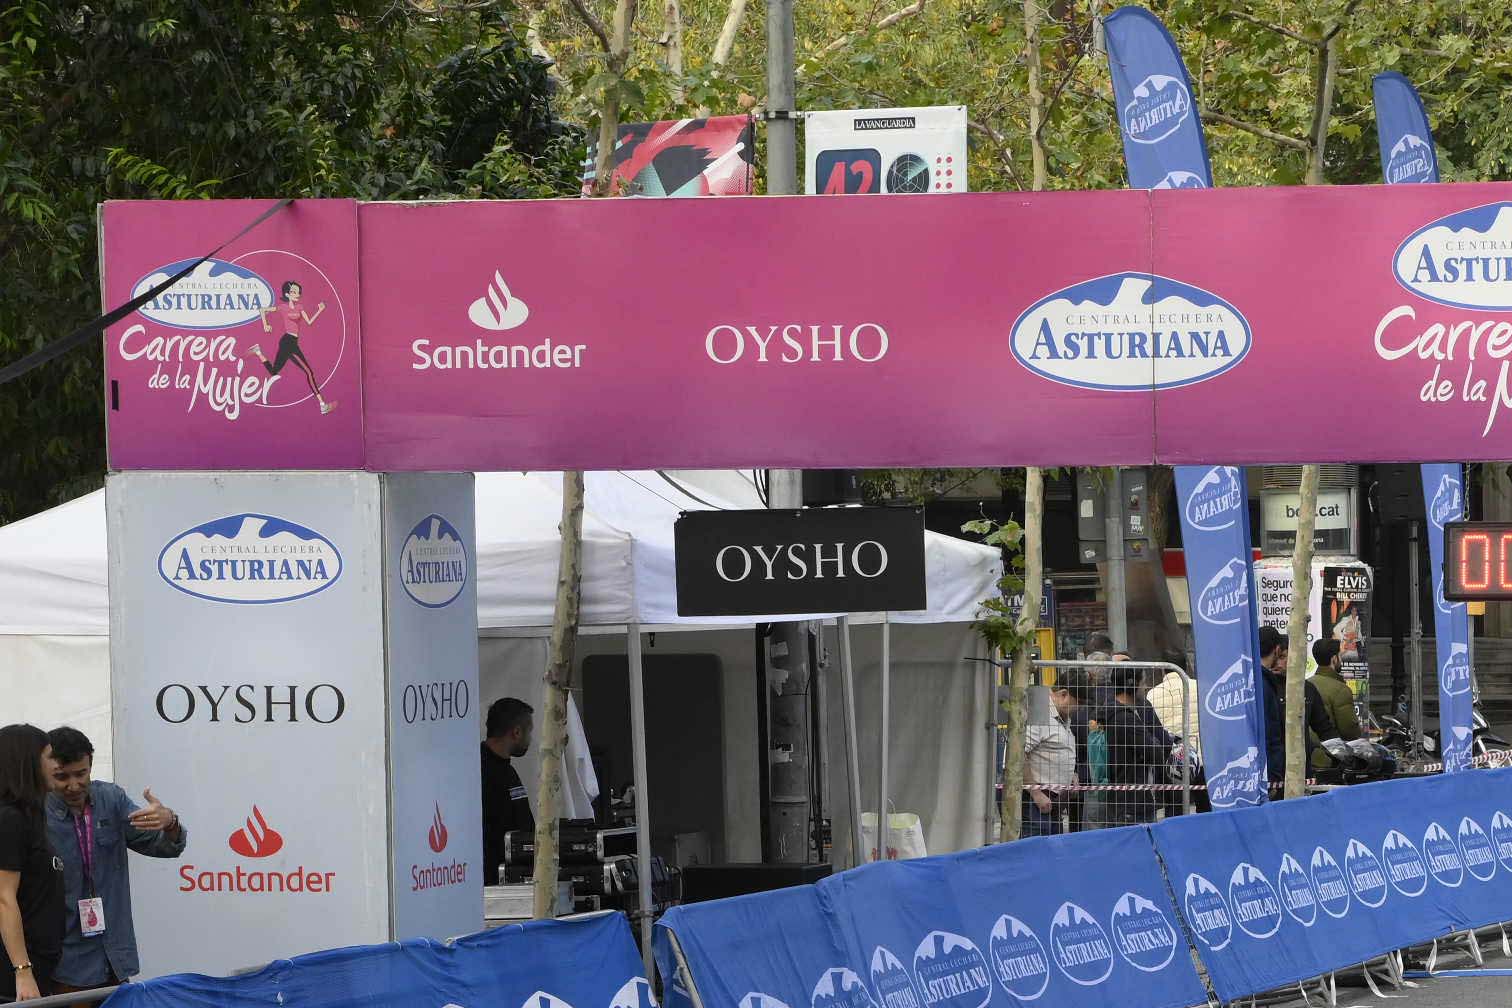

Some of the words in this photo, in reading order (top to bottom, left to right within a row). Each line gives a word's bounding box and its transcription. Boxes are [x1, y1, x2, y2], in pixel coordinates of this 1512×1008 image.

[855, 120, 865, 129] LA
[865, 117, 915, 129] VANGUARDIA
[143, 285, 262, 311] ASTURIANA
[171, 281, 208, 290] ENTRAL
[1065, 312, 1143, 326] CENTRAL
[1149, 312, 1225, 326] LECHERA
[119, 324, 238, 361] Carrera
[411, 337, 587, 371] Santander
[705, 322, 889, 363] OYSHO
[1028, 317, 1232, 361] ASTURIANA
[149, 362, 170, 389] de
[175, 362, 191, 389] la
[187, 358, 281, 420] Mujer
[1419, 363, 1454, 403] de
[1462, 362, 1487, 402] la
[172, 547, 329, 581] ASTURIANA
[200, 544, 259, 556] CENTRAL
[263, 544, 324, 555] LECHERA
[406, 549, 464, 585] ASTURIANA
[715, 540, 889, 582] OYSHO
[1336, 575, 1367, 588] ELVIS
[155, 683, 345, 724] OYSHO
[402, 679, 470, 724] OYSHO
[179, 864, 336, 893] Santander
[411, 862, 468, 893] Santander
[919, 967, 990, 1005] ASTURIANA
